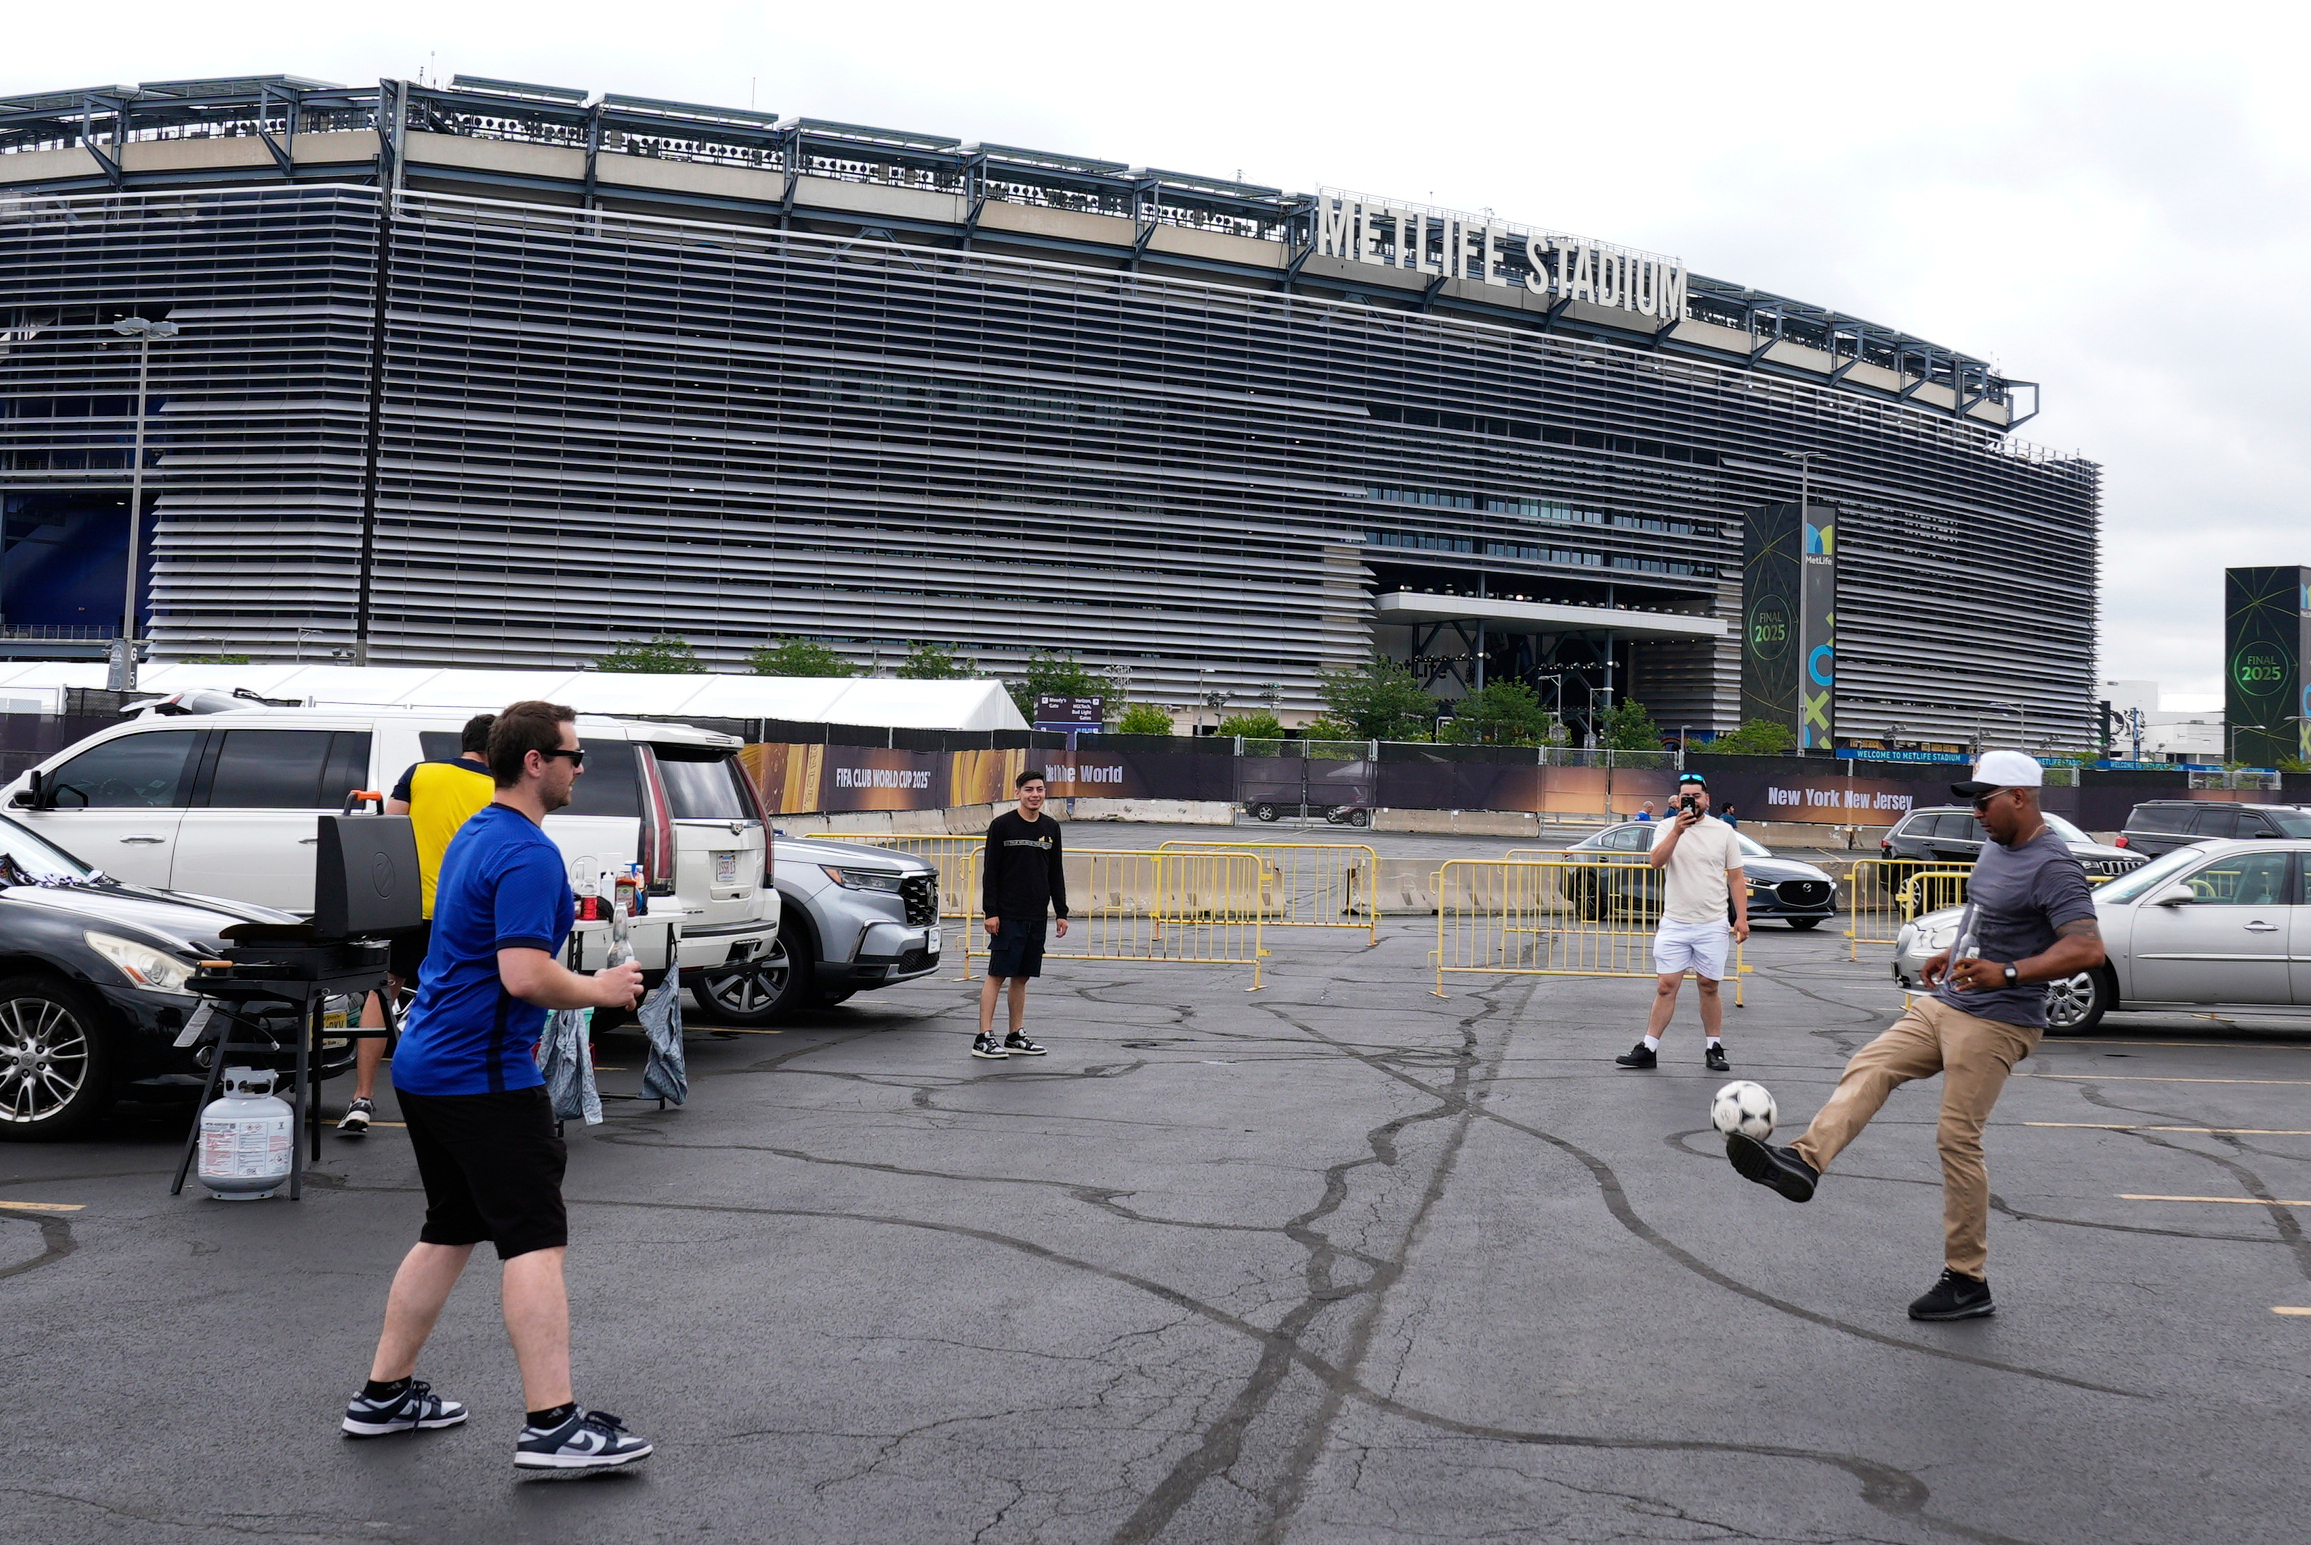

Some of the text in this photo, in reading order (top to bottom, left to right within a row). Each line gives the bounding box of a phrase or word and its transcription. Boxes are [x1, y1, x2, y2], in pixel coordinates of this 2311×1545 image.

[1317, 194, 1687, 323] METLIFE STADIUM
[1806, 555, 1833, 566] MetLife
[1759, 612, 1782, 623] FINAL
[1755, 624, 1786, 642] 2025
[131, 648, 138, 662] G
[2247, 656, 2277, 665] FINAL
[130, 672, 136, 686] 5
[2241, 666, 2281, 681] 2025
[1857, 750, 1961, 762] WELCOME TO METLIFE STADIUM
[836, 767, 852, 788] FIFA
[854, 768, 872, 788] CLUB
[872, 769, 898, 788] WORLD
[899, 770, 912, 788] CUP
[1080, 765, 1123, 784] World
[1768, 787, 1913, 814] New York New Jersey
